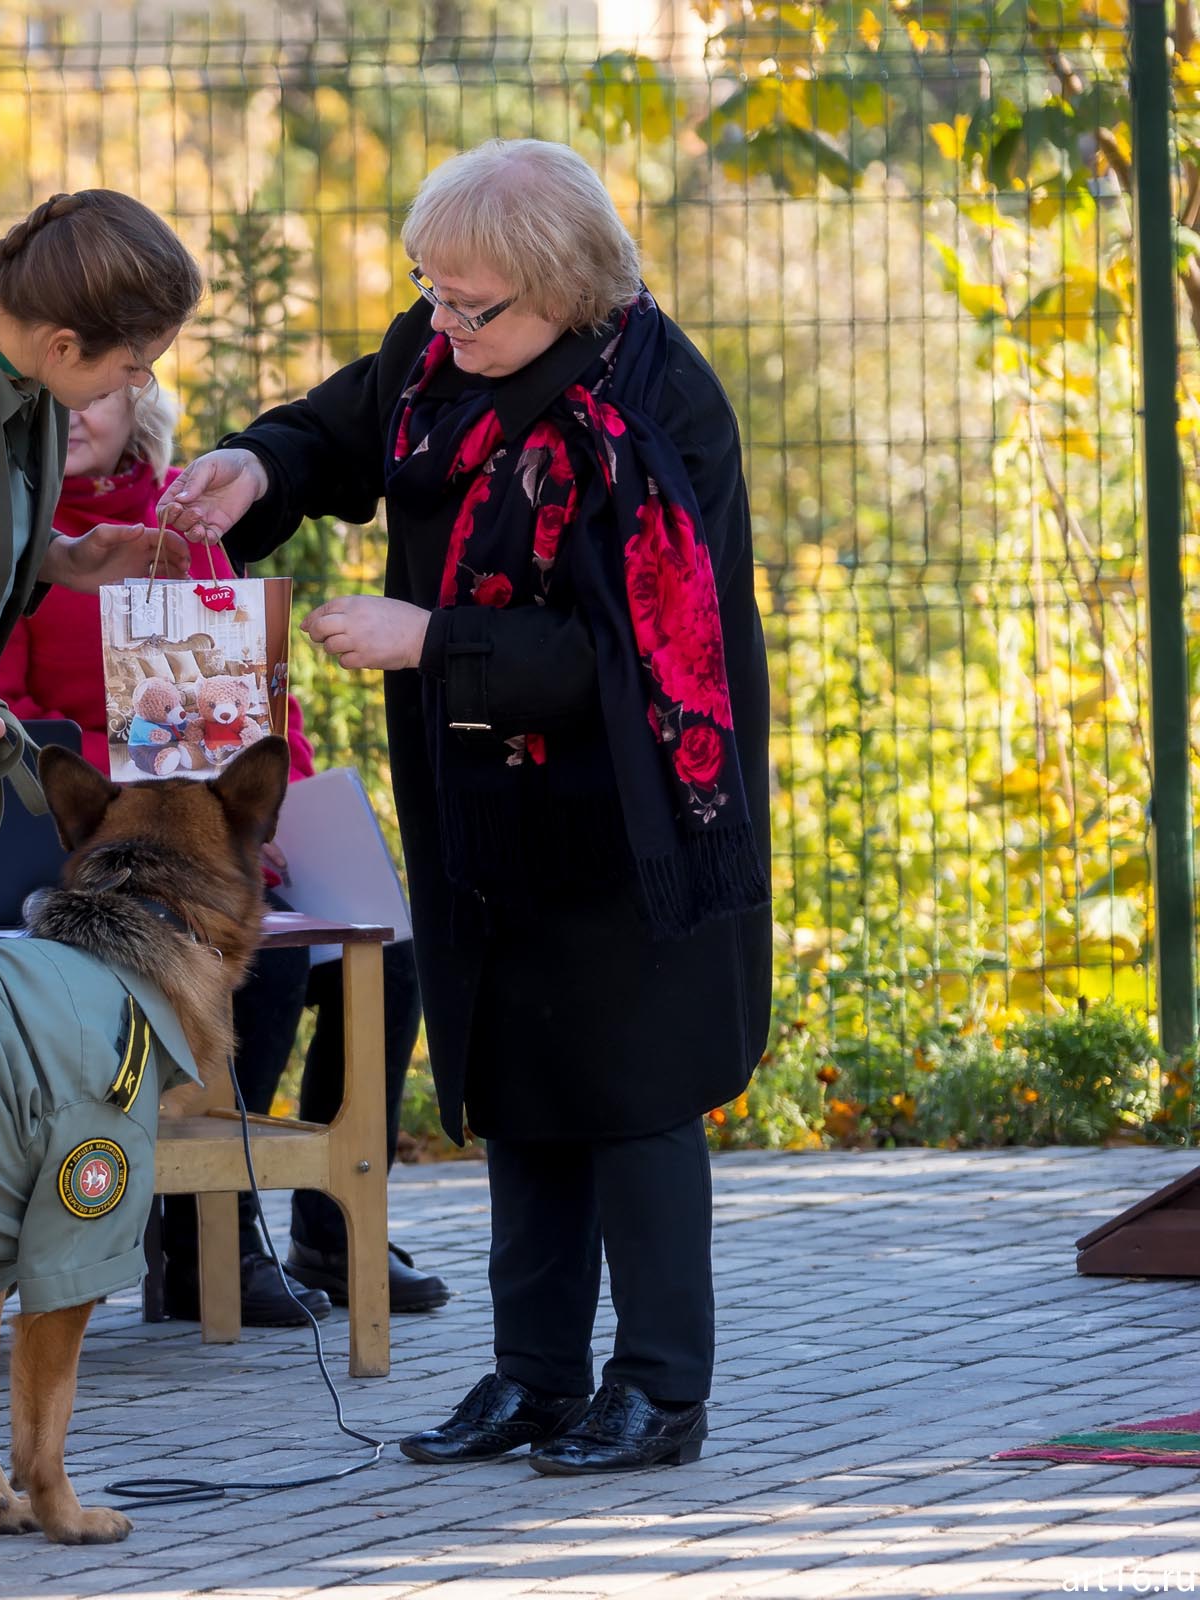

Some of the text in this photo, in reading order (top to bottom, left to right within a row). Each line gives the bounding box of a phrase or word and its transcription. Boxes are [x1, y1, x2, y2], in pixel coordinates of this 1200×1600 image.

[205, 591, 231, 602] LOVE
[72, 1143, 121, 1163] ЛИЦЕЙ МИЛИЦИИ
[63, 1168, 88, 1213] МИНИСТЕРСТВО
